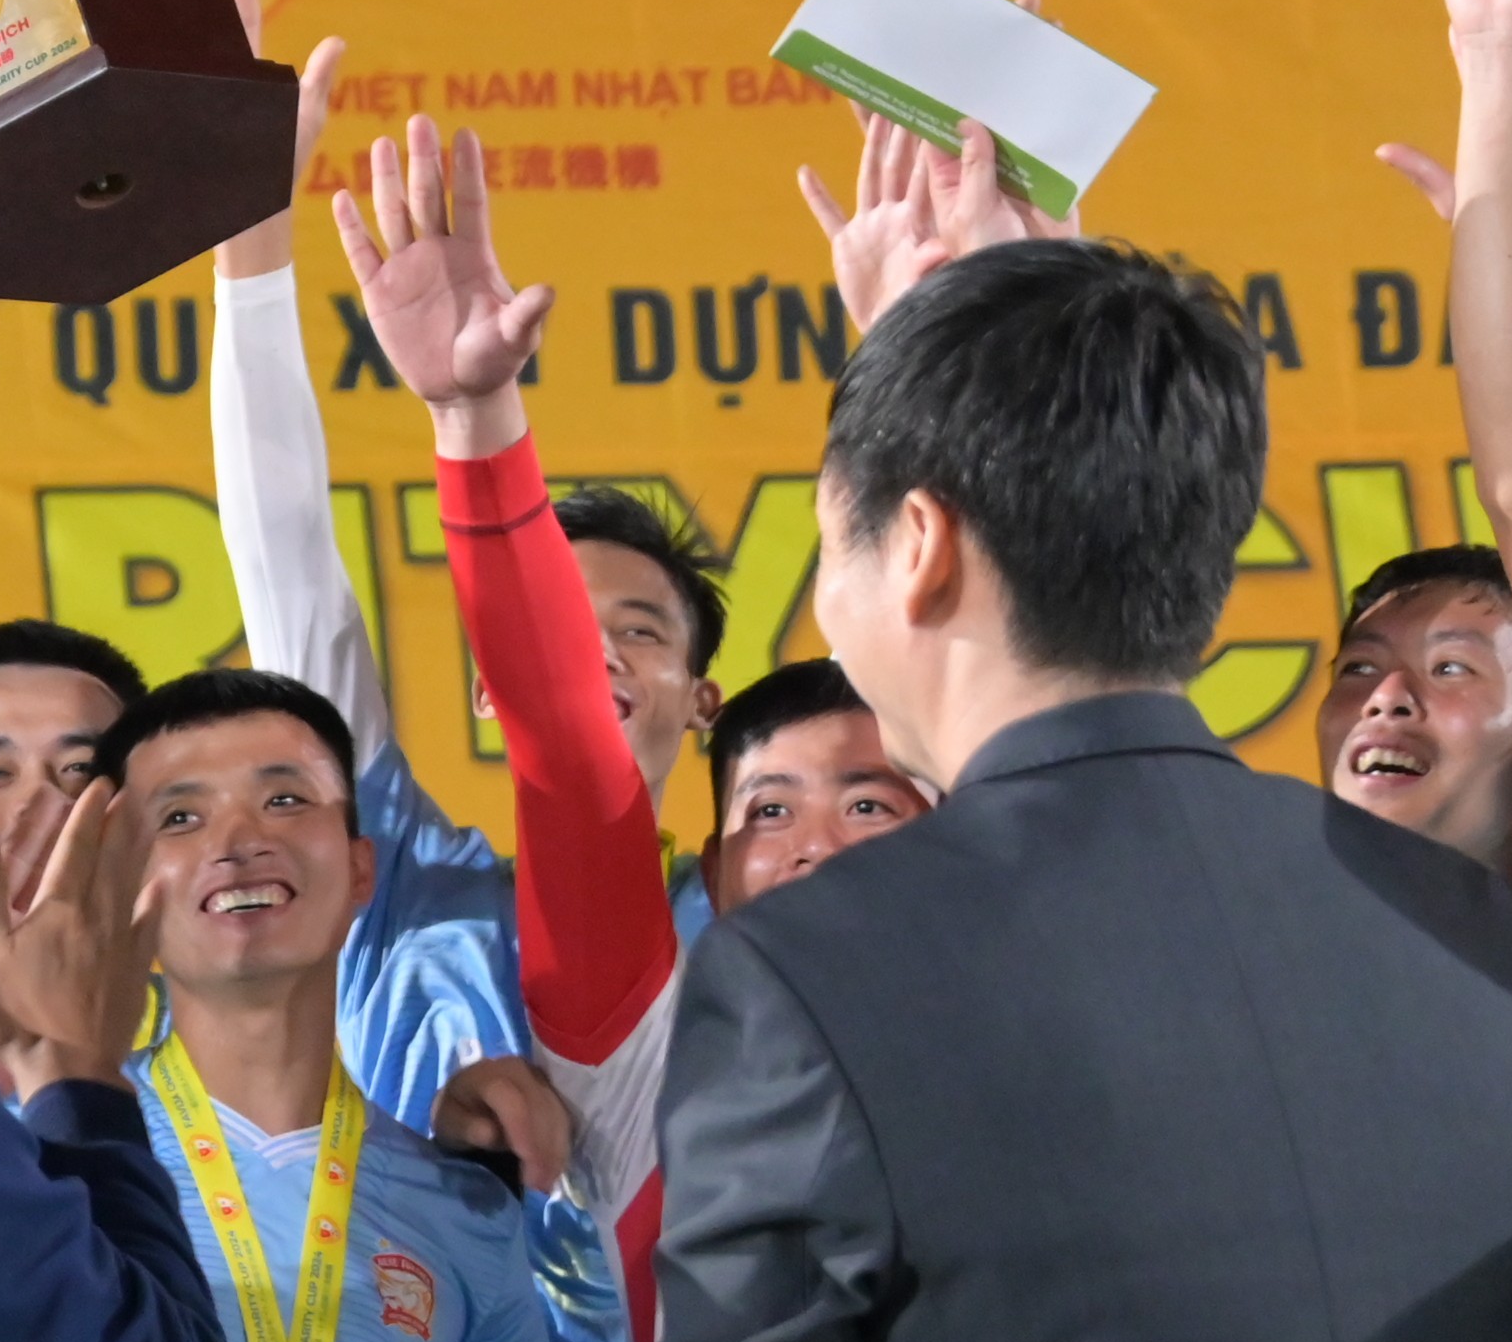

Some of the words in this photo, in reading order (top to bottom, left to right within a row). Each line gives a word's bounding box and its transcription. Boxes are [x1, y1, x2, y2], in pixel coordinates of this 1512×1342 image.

[24, 52, 49, 70] CUP
[50, 37, 78, 57] 2024
[443, 68, 558, 112] NAM
[236, 1262, 255, 1288] CUP
[310, 1250, 324, 1280] 2024
[305, 1281, 319, 1307] CUP
